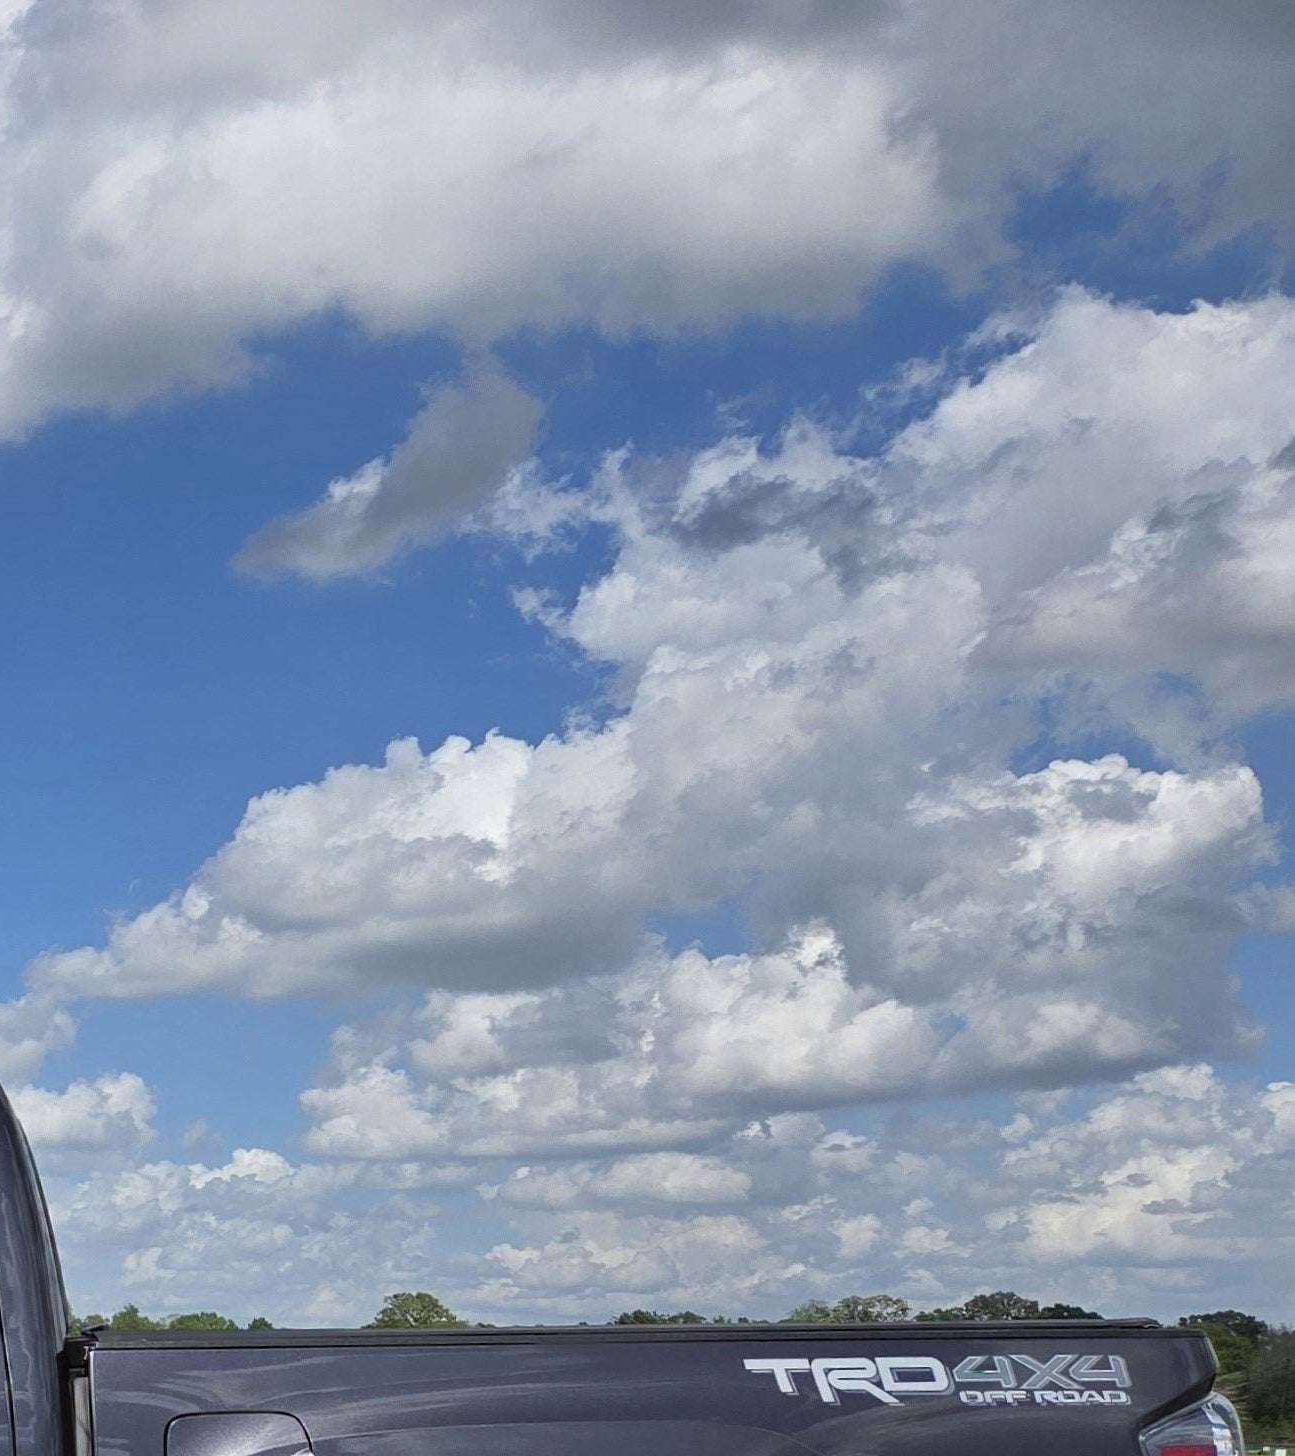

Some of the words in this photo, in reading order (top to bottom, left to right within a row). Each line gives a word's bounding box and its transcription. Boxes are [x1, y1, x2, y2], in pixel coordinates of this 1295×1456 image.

[743, 1356, 955, 1406] TRD
[959, 1390, 1027, 1407] OFF
[1034, 1390, 1133, 1407] ROAD
